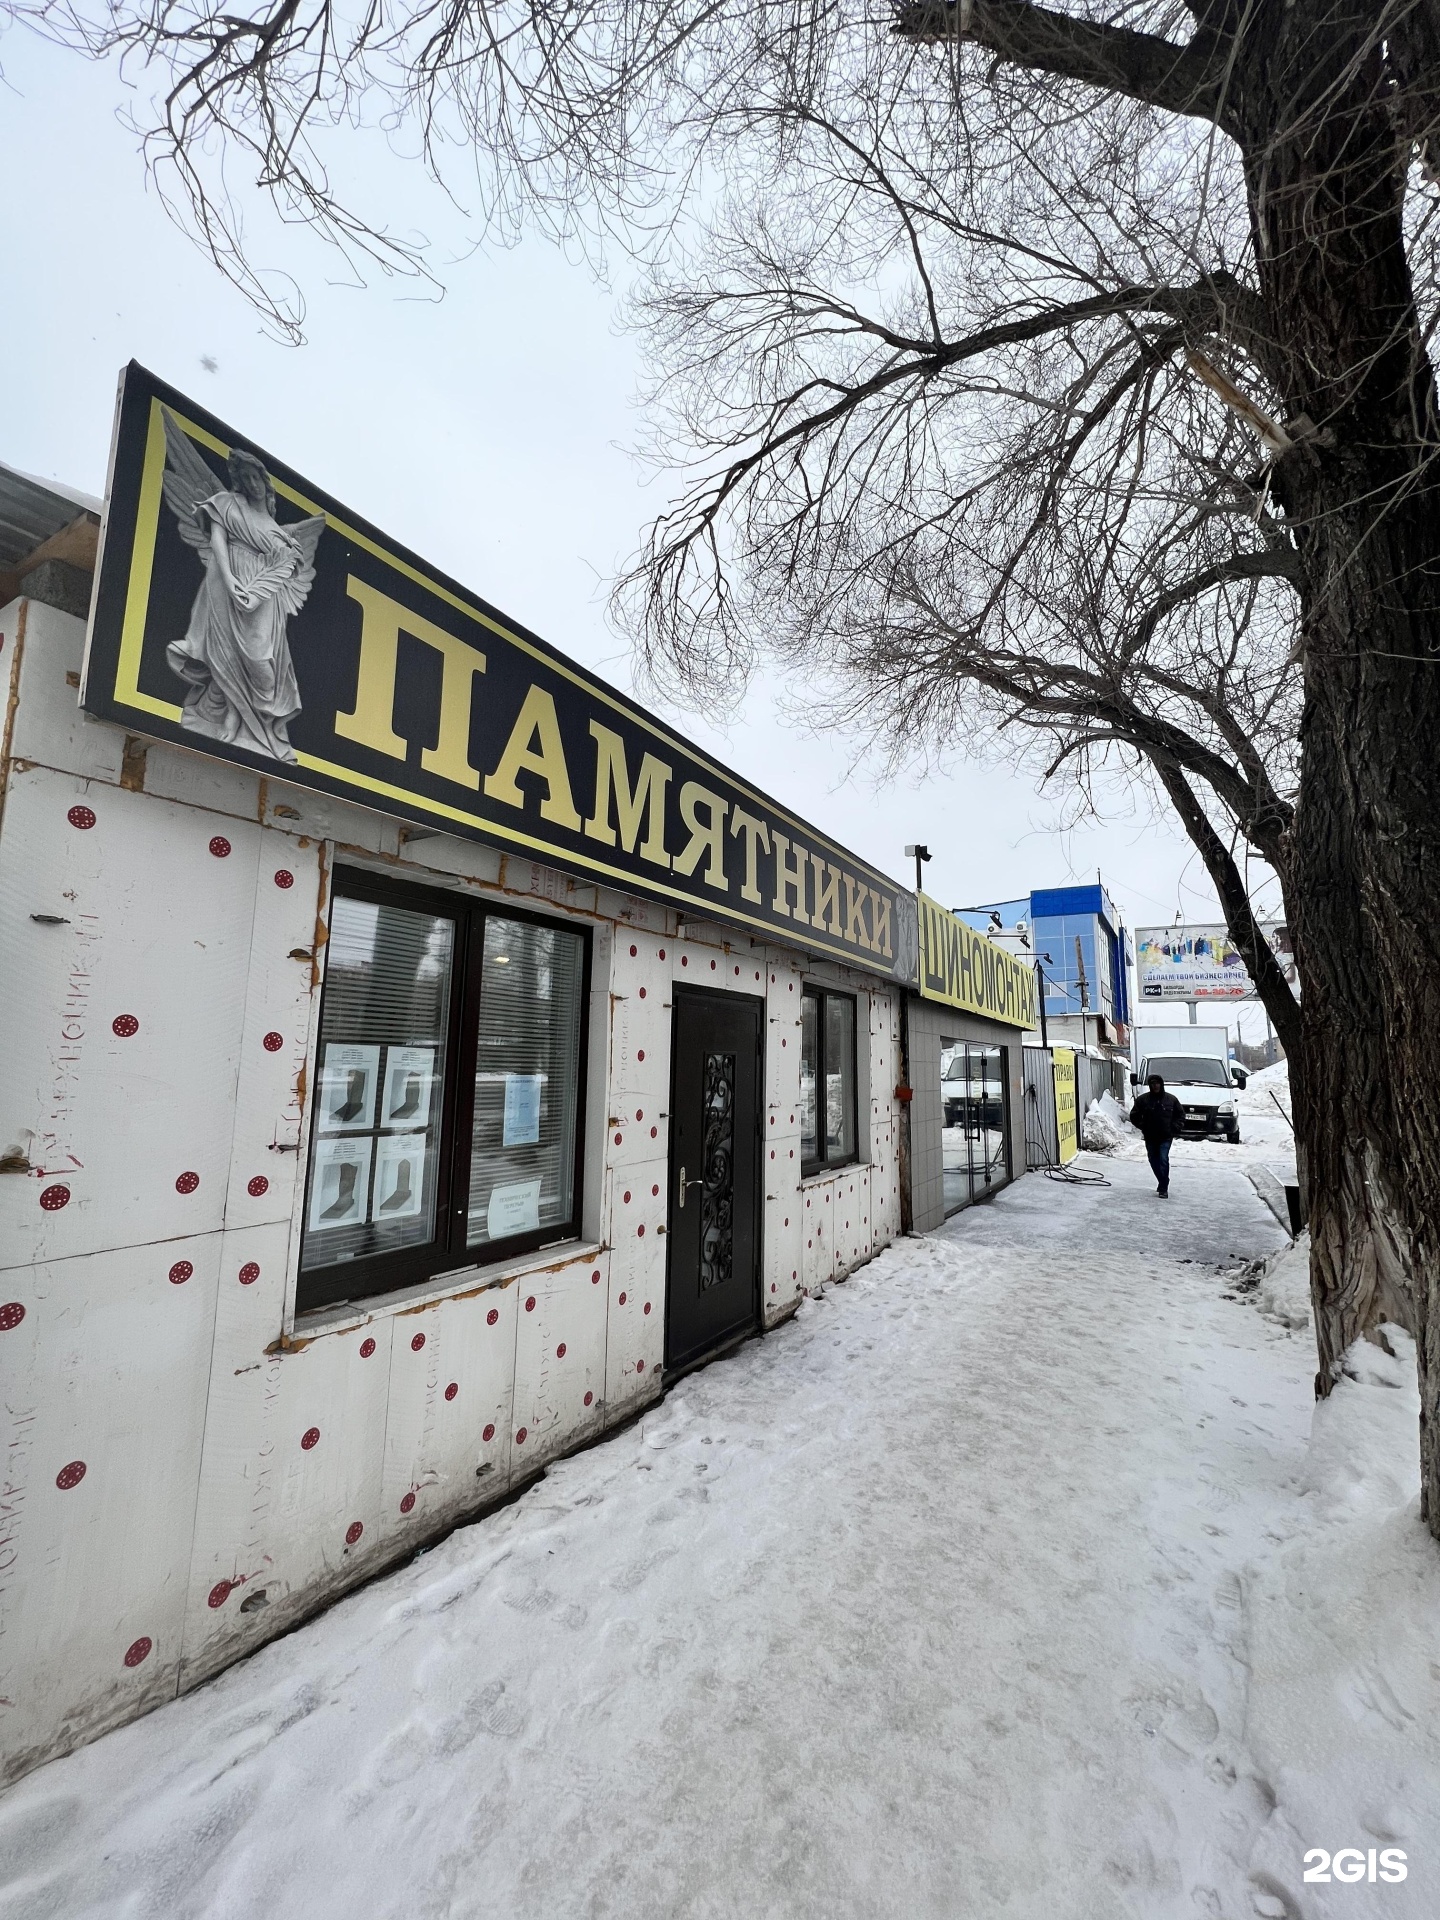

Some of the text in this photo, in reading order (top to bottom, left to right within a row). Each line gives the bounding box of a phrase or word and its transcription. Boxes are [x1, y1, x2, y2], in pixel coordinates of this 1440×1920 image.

[335, 573, 894, 960] ПАМЯТНИКИ
[922, 901, 1036, 1025] ШИНОМОНТАЖ
[1195, 972, 1222, 980] БИЗНЕС
